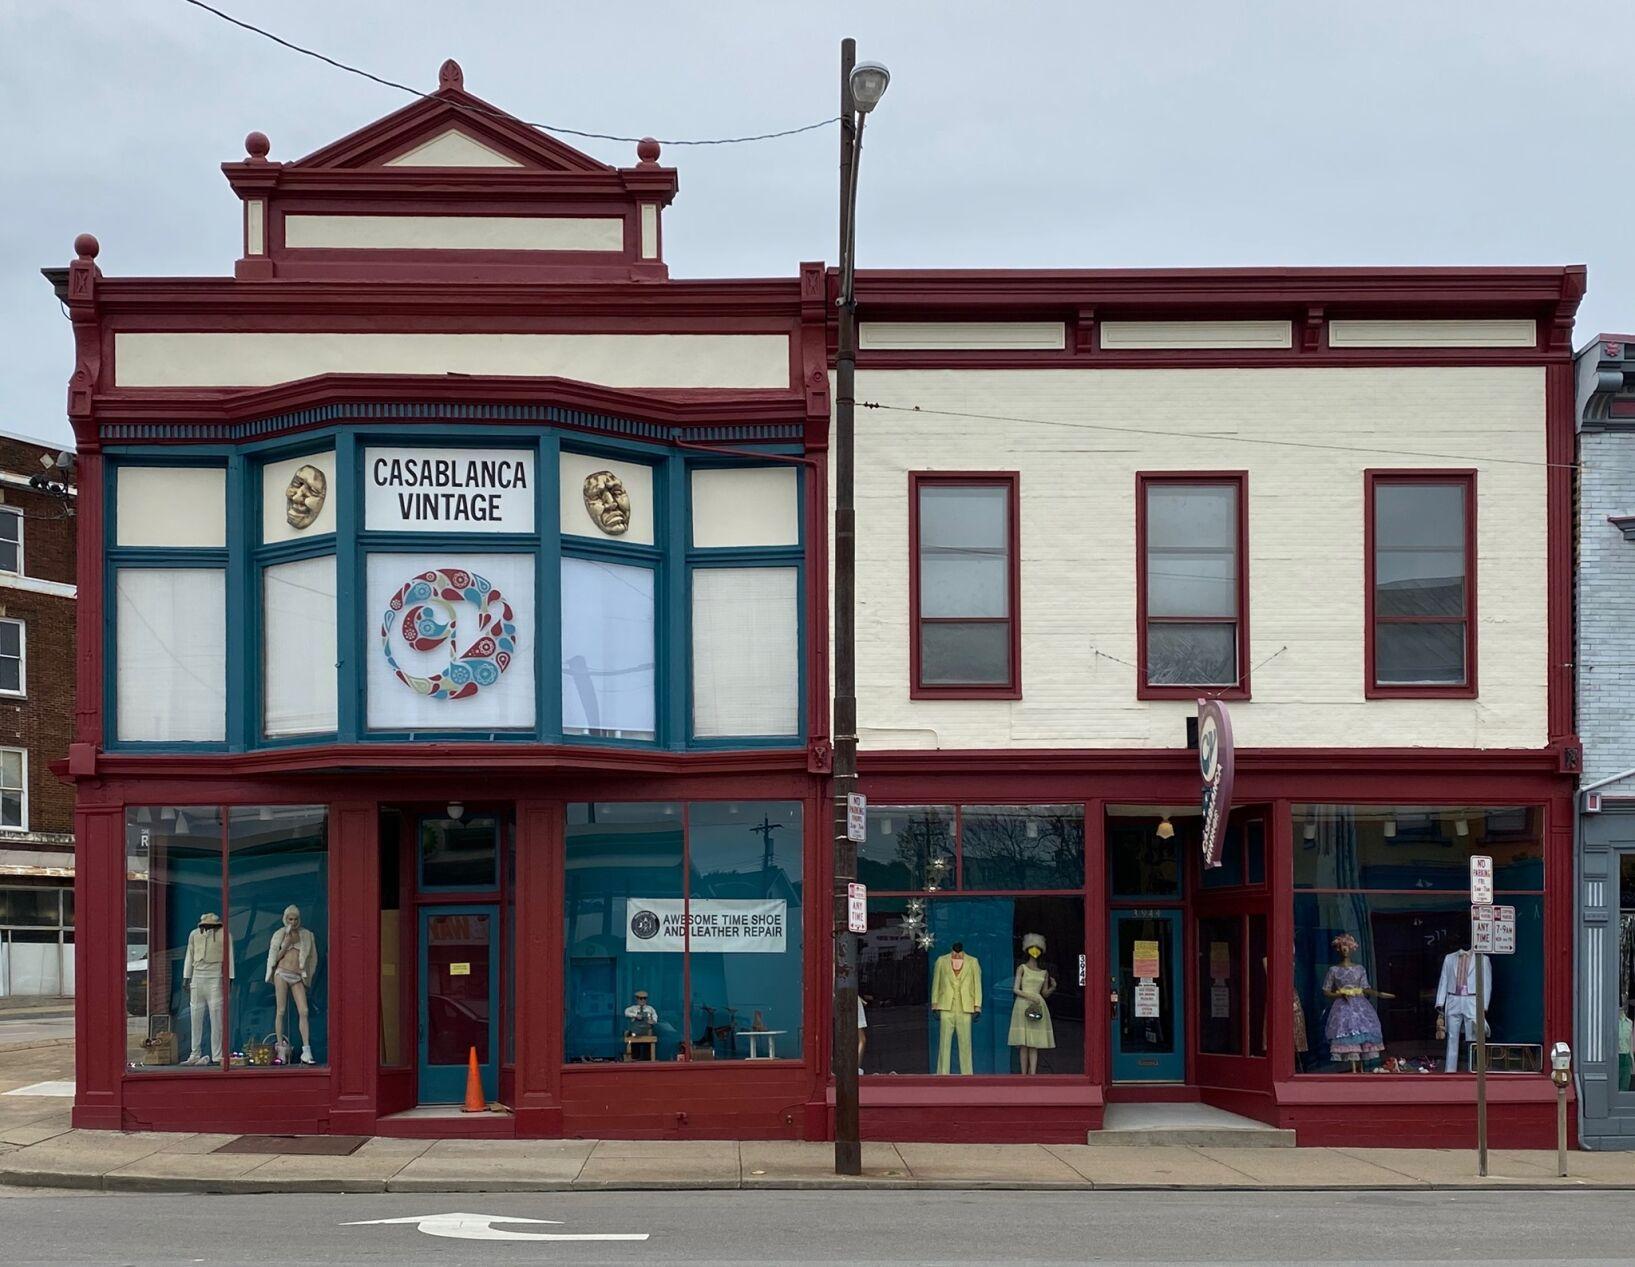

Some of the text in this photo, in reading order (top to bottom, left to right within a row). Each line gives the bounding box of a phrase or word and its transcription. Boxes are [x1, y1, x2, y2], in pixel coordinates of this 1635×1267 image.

[374, 458, 527, 489] CASABLANCA
[398, 493, 502, 521] VINTAGE
[1477, 859, 1486, 868] NO
[852, 901, 863, 911] ANY
[663, 914, 781, 925] AWESOME TIME SHOE
[851, 911, 864, 922] TIME
[664, 927, 783, 937] AND LEATHER REPAIR
[1477, 923, 1489, 932] ANY
[1476, 933, 1490, 943] TIME
